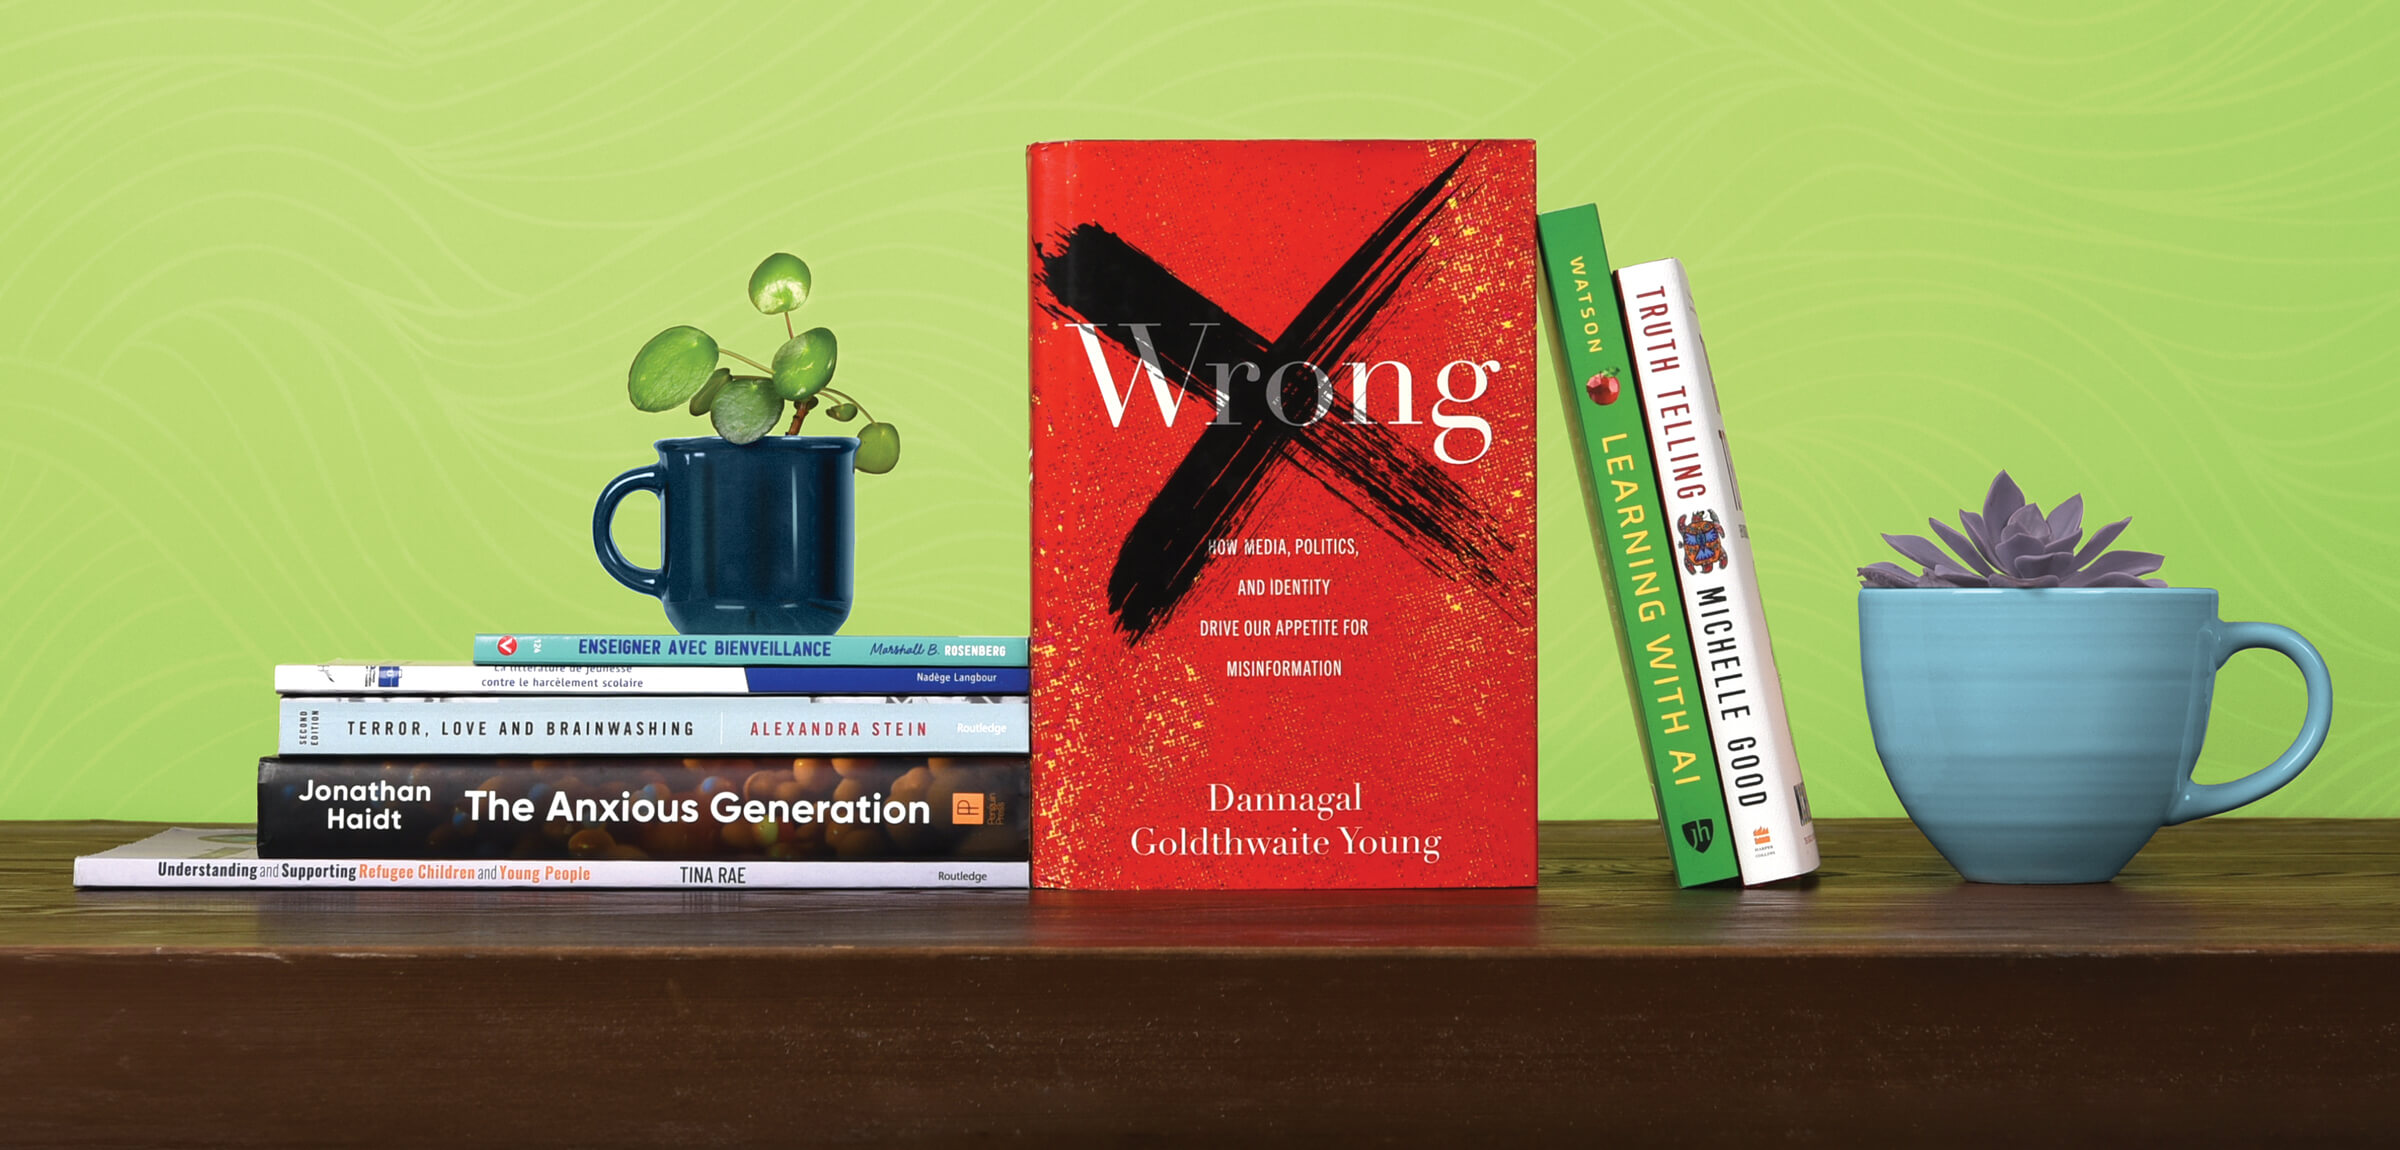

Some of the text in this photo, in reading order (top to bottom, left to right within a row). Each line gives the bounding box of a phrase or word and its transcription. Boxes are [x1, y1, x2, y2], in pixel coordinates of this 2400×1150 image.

[1570, 255, 1603, 353] WATSON
[1064, 322, 1501, 465] Wrong
[1636, 285, 1707, 500] TRUTH TELLING
[1208, 538, 1360, 559] HOW MEDIA, POLITICS,
[1238, 578, 1331, 596] AND IDENTITY
[1601, 432, 1701, 786] LEARNING WITH AI
[1200, 618, 1369, 637] DRIVE OUR APPETITE FOR
[578, 638, 832, 658] ENSEIGNER AVEC BIENVEILLANCE
[869, 642, 1007, 657] Marshall B. ROSENBERG
[916, 672, 997, 684] Nadège Langbour
[1226, 660, 1343, 678] MISINFORMATION
[481, 677, 644, 688] contre le harcèlement scolaire
[1696, 586, 1768, 807] MICHELLE GOOD
[299, 710, 308, 745] SECOND
[310, 710, 319, 746] EDITION
[347, 721, 695, 737] TERROR, LOVE AND BRAINWASHING
[750, 721, 926, 737] ALEXANDRA STEIN
[957, 722, 1007, 735] Routledge
[298, 779, 431, 803] Jonathan
[1207, 782, 1363, 821] Dannagal
[465, 790, 931, 825] The Anxious Generation
[327, 807, 402, 831] Haidt
[1130, 826, 1443, 864] Goldthwaite Young
[157, 861, 591, 883] Understanding and Supporting Refugee Children and Young People
[680, 866, 746, 884] TINA RAE
[938, 870, 988, 883] Routledge
